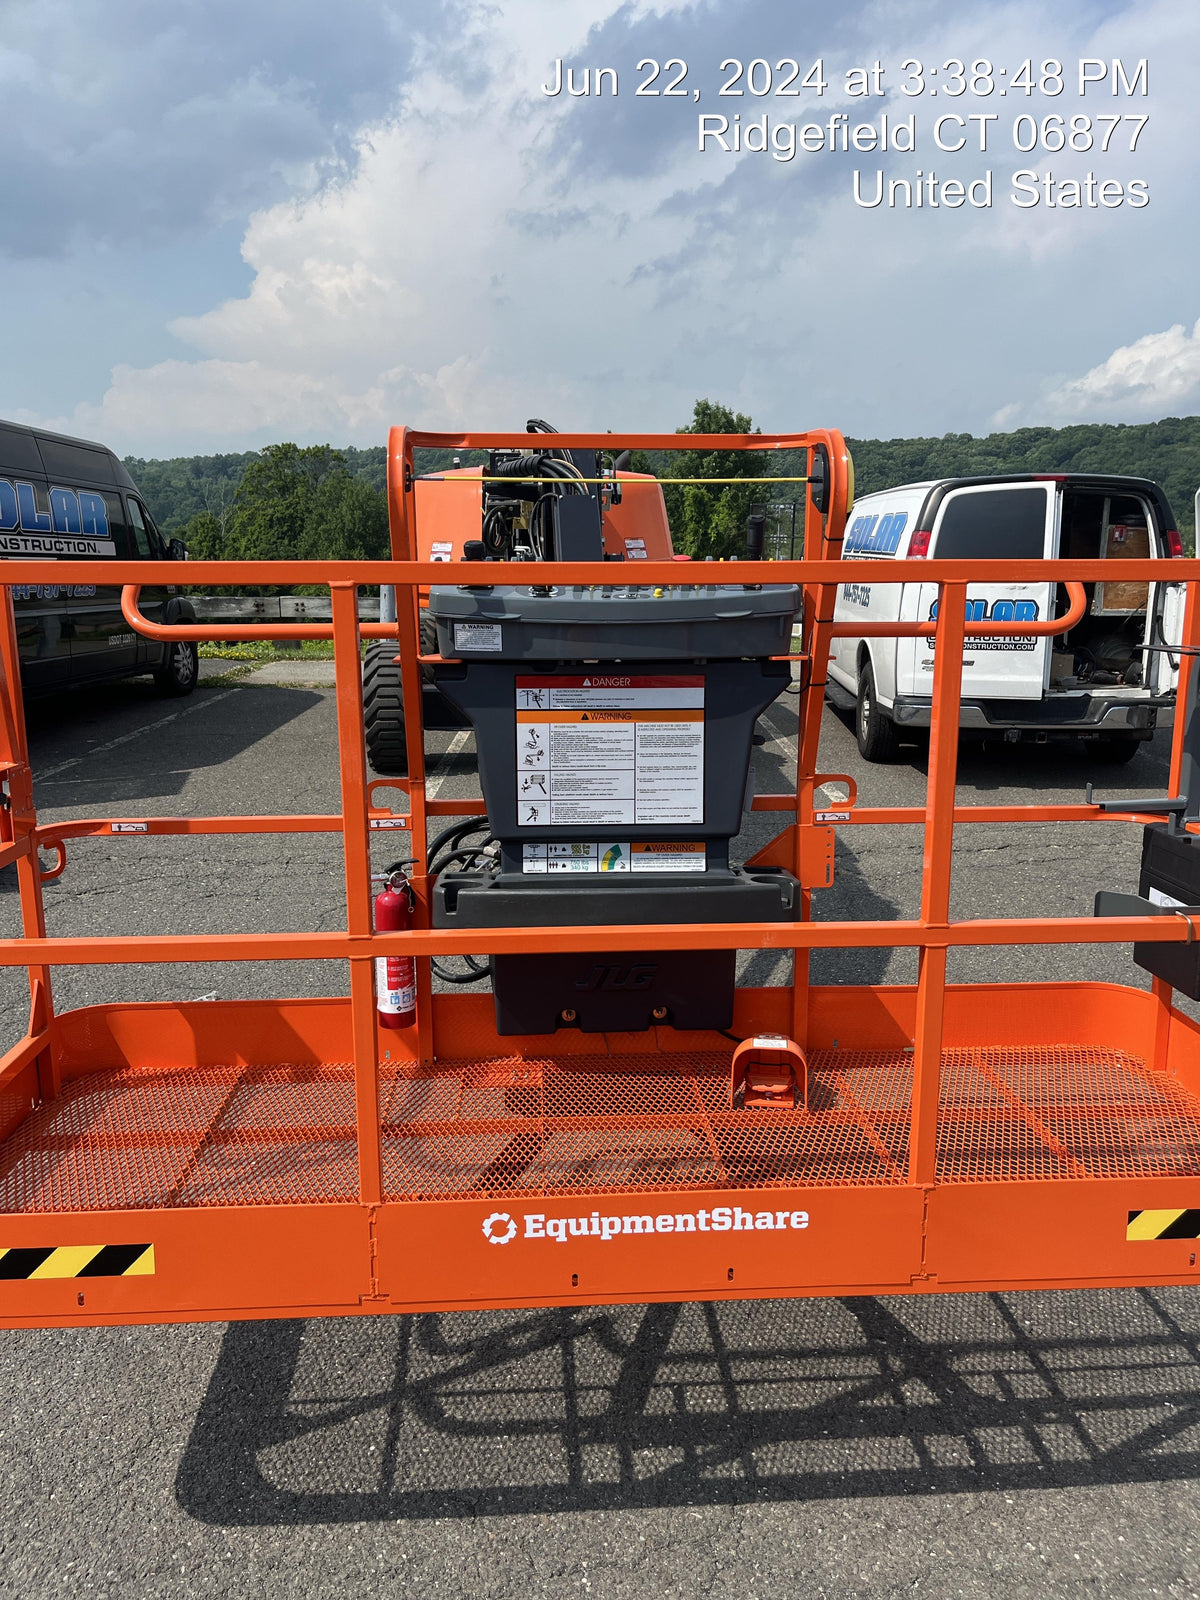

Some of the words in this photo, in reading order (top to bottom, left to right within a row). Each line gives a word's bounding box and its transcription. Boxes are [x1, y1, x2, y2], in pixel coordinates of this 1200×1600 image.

[844, 511, 909, 557] SOLAR
[592, 677, 631, 686] DANGER
[590, 712, 632, 721] WARNING
[652, 843, 695, 852] WARNING
[574, 963, 659, 991] JLG
[523, 1207, 809, 1242] EquipmentShare
